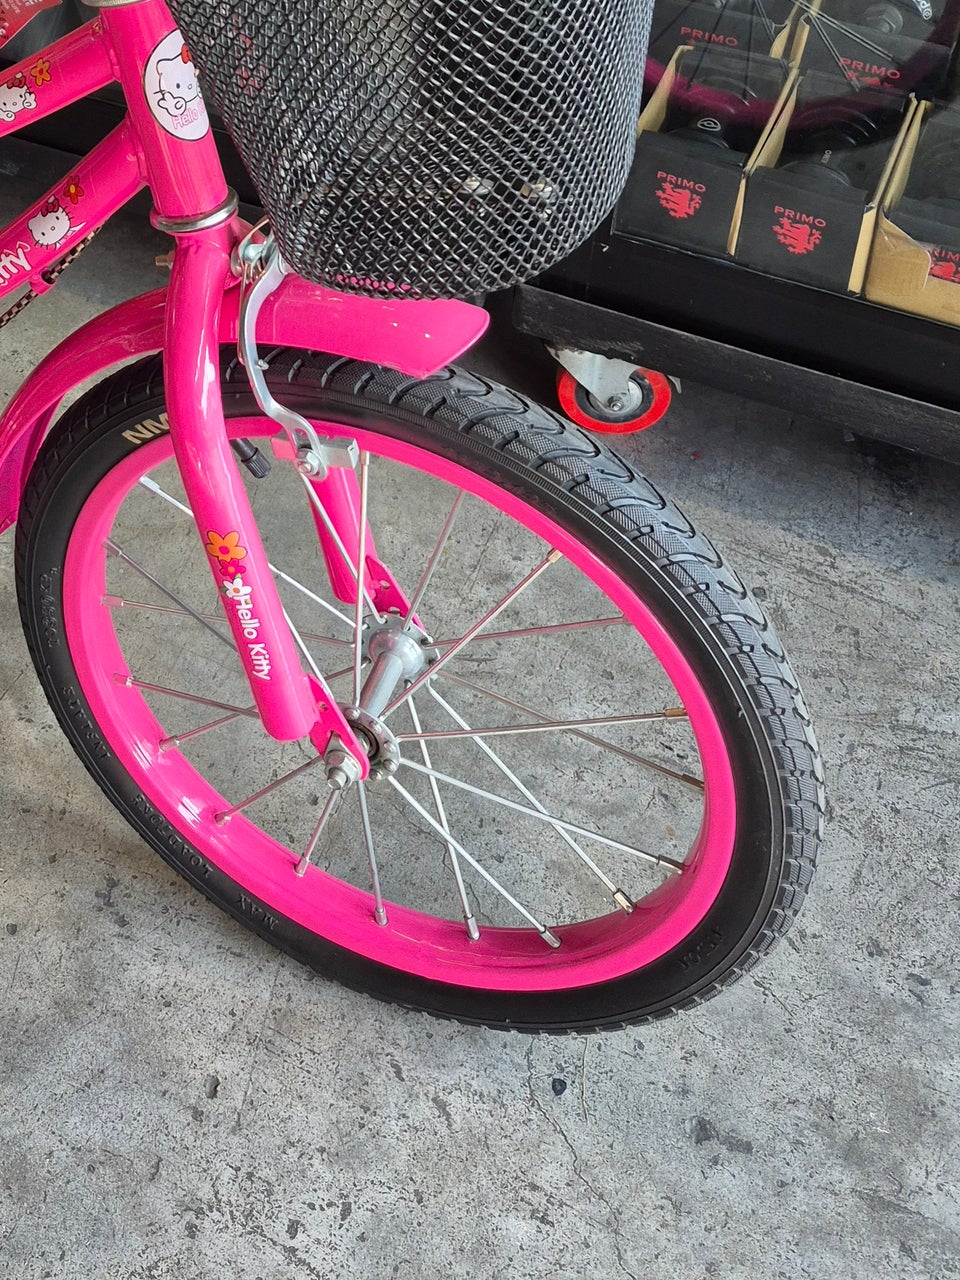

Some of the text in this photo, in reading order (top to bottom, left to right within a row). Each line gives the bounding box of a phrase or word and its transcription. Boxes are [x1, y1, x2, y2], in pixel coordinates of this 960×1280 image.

[680, 26, 738, 47] PRIMO
[839, 57, 901, 79] PRIMO
[171, 107, 199, 129] Hello
[656, 170, 706, 193] PRIMO
[774, 205, 827, 228] PRIMO
[932, 248, 960, 262] RIM
[233, 590, 271, 681] Hello Kitty
